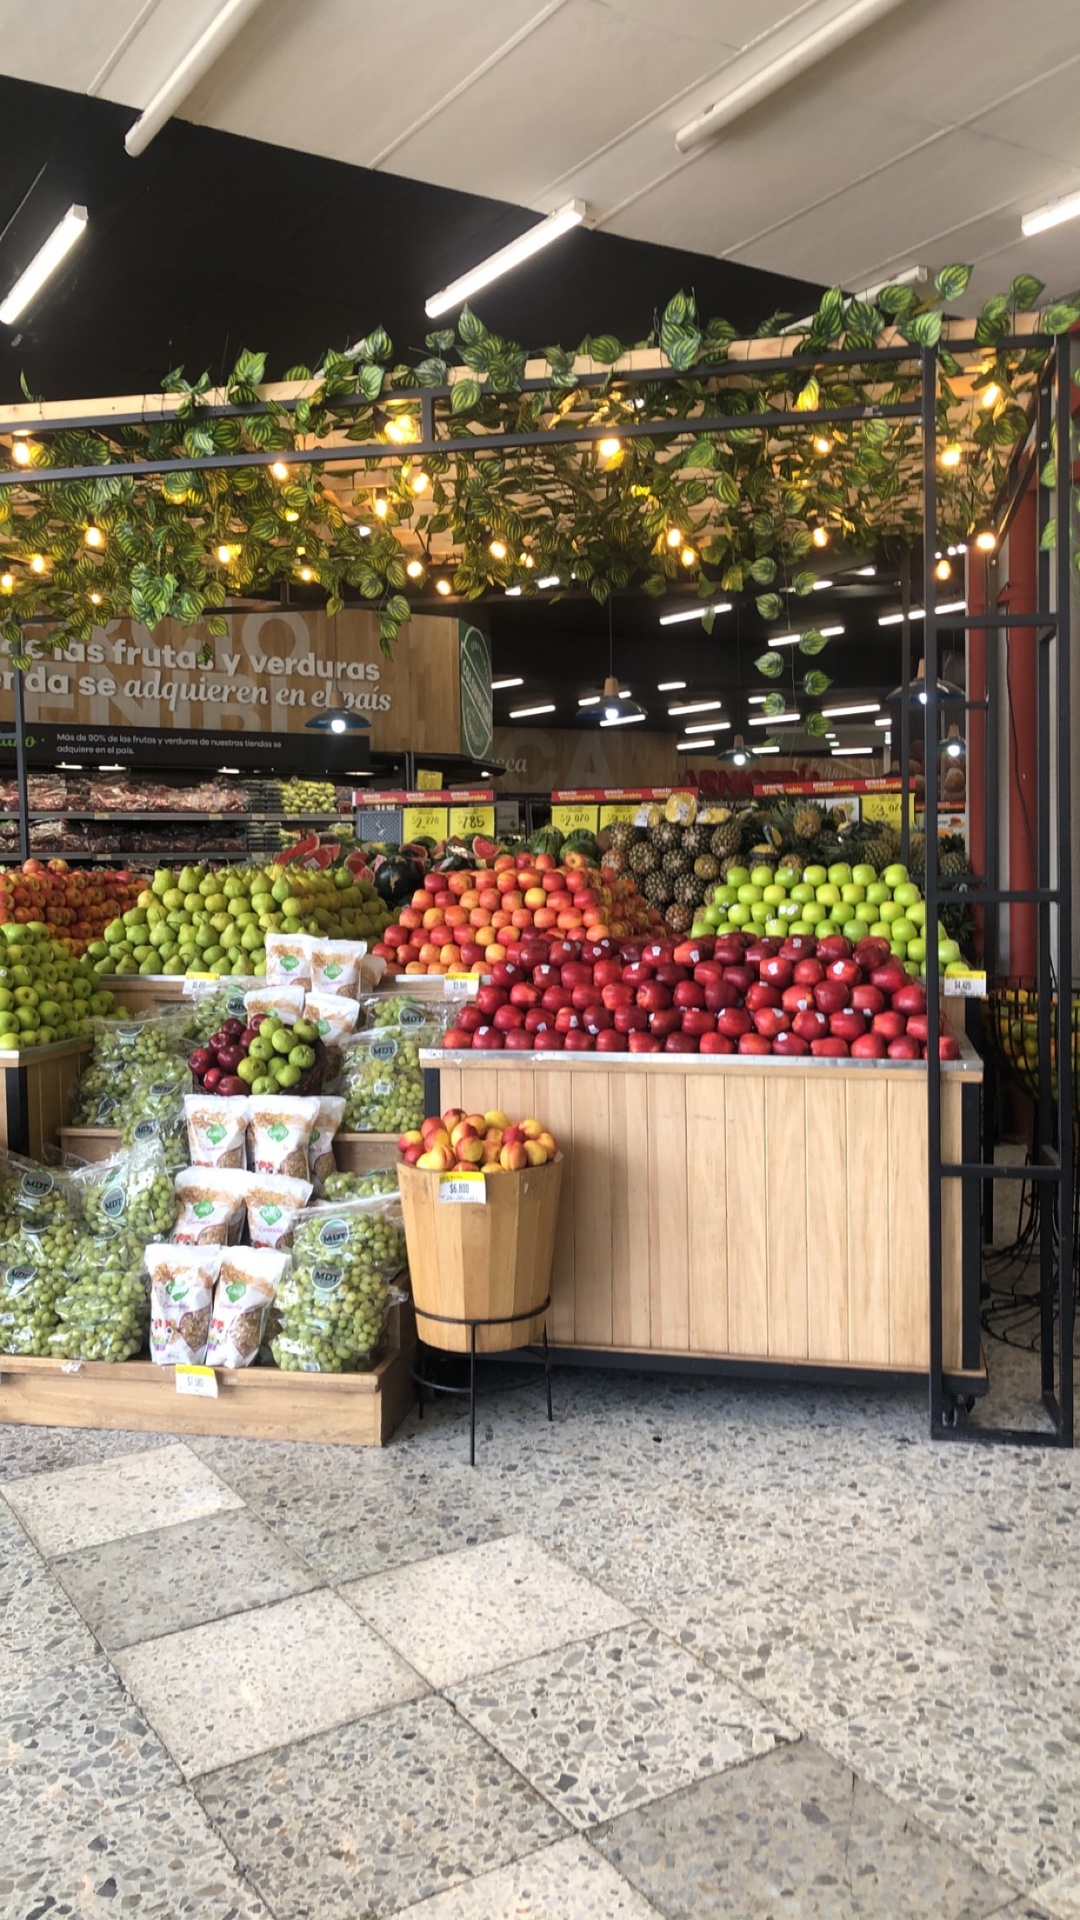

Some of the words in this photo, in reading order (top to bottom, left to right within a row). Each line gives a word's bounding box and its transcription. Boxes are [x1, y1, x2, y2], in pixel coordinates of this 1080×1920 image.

[221, 653, 241, 678] y
[250, 652, 381, 682] verduras
[0, 665, 69, 695] nda
[78, 674, 117, 696] se
[123, 670, 269, 712] adquieren
[275, 687, 306, 706] en
[311, 680, 332, 707] el
[56, 733, 75, 742] Más
[75, 734, 87, 742] de
[87, 733, 107, 743] 90%
[107, 734, 119, 743] de
[119, 734, 132, 743] las
[132, 735, 156, 745] frutas
[157, 738, 163, 746] y
[164, 737, 199, 746] verduras
[199, 738, 210, 746] de
[210, 739, 244, 747] nuestras
[244, 739, 272, 748] tiendas
[273, 740, 282, 748] se
[56, 745, 94, 754] adquiere
[94, 746, 106, 754] en
[107, 746, 115, 754] el
[373, 1046, 394, 1055] MDT
[25, 1179, 49, 1191] MDT
[105, 1198, 123, 1211] MDT
[314, 1271, 341, 1282] MDT
